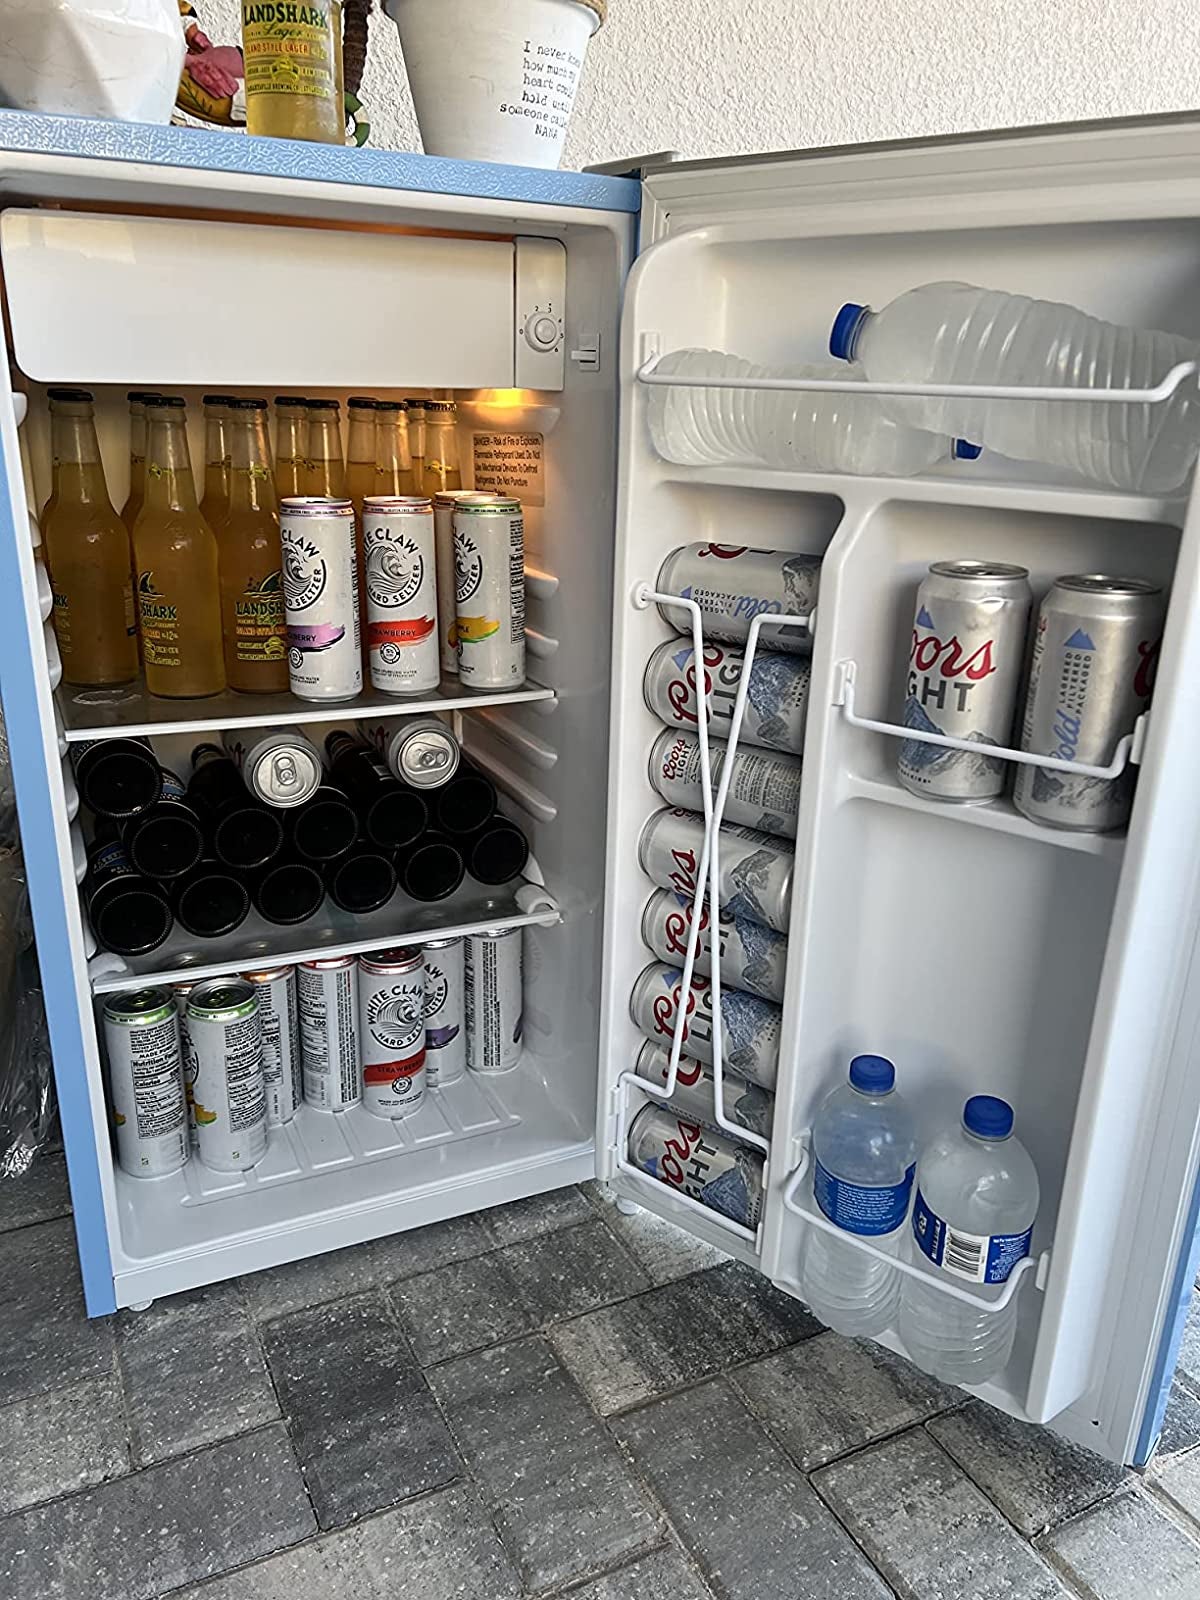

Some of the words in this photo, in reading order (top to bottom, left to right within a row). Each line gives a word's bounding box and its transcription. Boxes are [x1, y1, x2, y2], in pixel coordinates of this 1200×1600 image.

[243, 2, 329, 29] LANDSHARK
[263, 22, 303, 41] Lager
[285, 41, 309, 54] LAGER
[523, 40, 531, 53] I
[537, 45, 567, 61] never
[522, 57, 545, 73] how
[547, 64, 568, 79] much
[523, 72, 554, 90] heart
[521, 90, 548, 107] hold
[499, 103, 549, 122] someone
[534, 123, 558, 140] NANA
[281, 528, 321, 558] CLAW
[374, 527, 419, 554] CLAW
[452, 523, 478, 554] LAW
[295, 567, 323, 607] SELTZER
[367, 585, 389, 604] HARD
[392, 563, 421, 603] SELTZER
[141, 602, 177, 619] SHARK
[235, 601, 285, 615] LANDSH
[699, 604, 730, 615] LAGER
[733, 595, 783, 619] Cold
[373, 629, 417, 638] RAWBERRY
[910, 629, 997, 680] ors
[1058, 651, 1074, 705] LAGERED
[1066, 653, 1083, 709] FILTERED
[1075, 654, 1093, 715] PACKAGED
[907, 670, 977, 713] GHT
[662, 738, 686, 781] Coors
[675, 744, 693, 780] LIGHT
[366, 989, 390, 1025] WHITE
[424, 985, 445, 1014] ELTZER
[313, 1019, 327, 1027] 100
[265, 1034, 280, 1043] 100
[378, 1032, 404, 1046] HARD
[132, 1056, 164, 1067] Nutrition
[226, 1049, 254, 1061] Nutrition
[134, 1079, 161, 1087] Calories
[658, 1119, 701, 1185] ors
[684, 1137, 718, 1200] GHT
